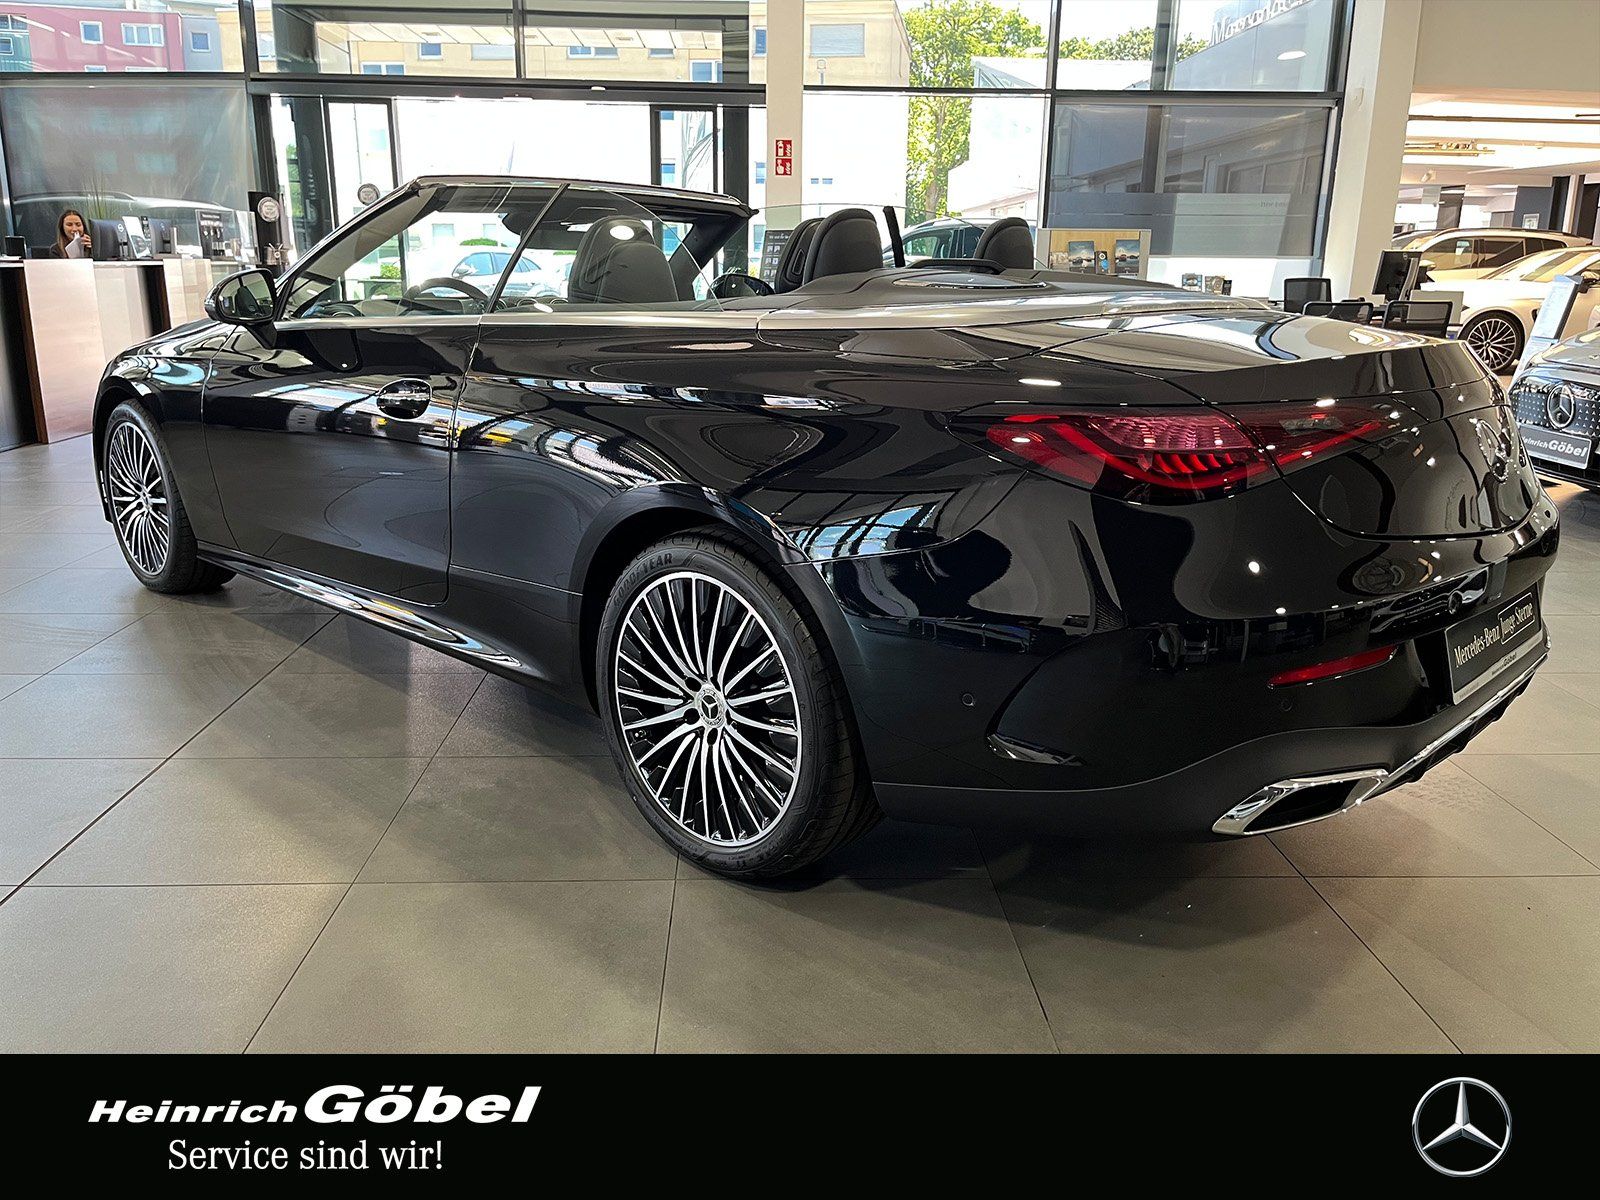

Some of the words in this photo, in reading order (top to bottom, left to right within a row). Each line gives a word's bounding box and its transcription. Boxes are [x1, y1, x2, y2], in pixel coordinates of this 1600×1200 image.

[1548, 439, 1589, 457] Göbel
[1454, 626, 1500, 668] Mercedes-Benz
[1500, 614, 1515, 639] Junge
[1515, 602, 1533, 625] Sterne
